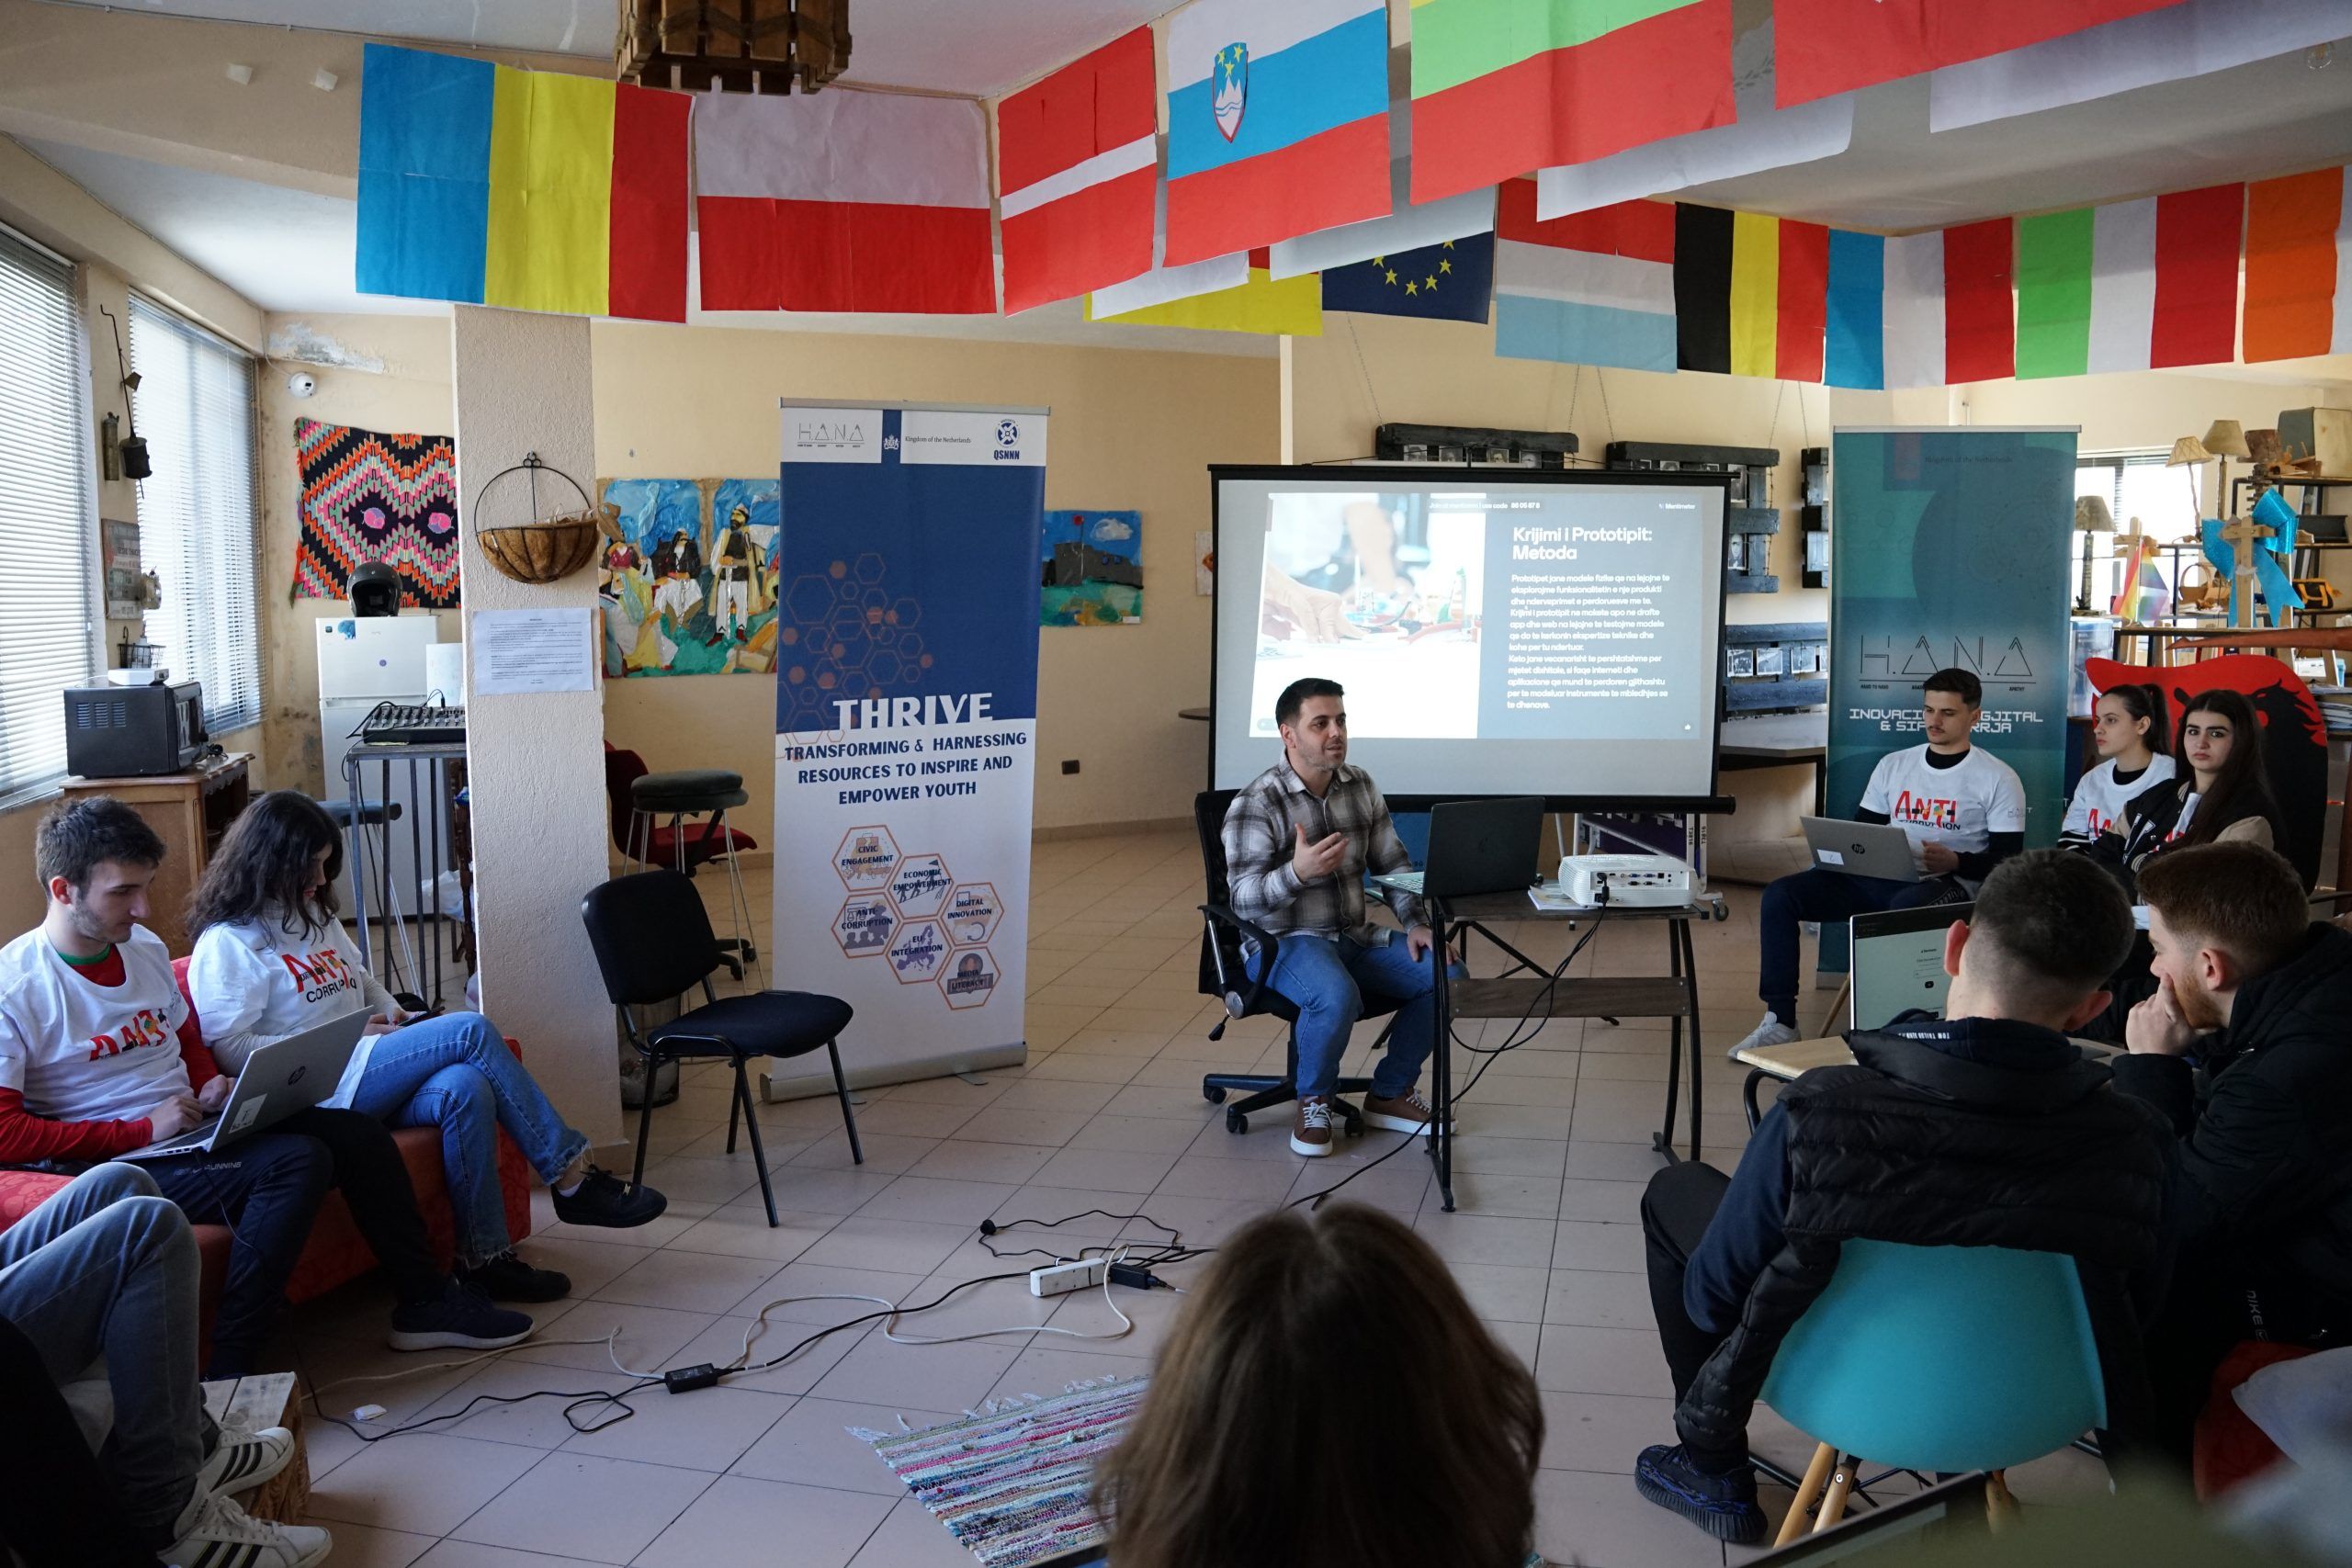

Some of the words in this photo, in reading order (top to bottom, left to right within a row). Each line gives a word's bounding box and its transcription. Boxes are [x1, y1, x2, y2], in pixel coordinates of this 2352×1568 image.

[1513, 527, 1561, 545] Krijimi
[1573, 527, 1653, 544] Prototipit:
[1513, 545, 1577, 560] Metoda
[1511, 573, 1548, 584] Prototipet
[1566, 573, 1594, 582] modele
[1595, 573, 1613, 582] fizike
[1614, 575, 1624, 584] qe
[1637, 573, 1661, 584] lejojne
[1662, 573, 1669, 582] te
[1619, 585, 1630, 596] nje
[1631, 585, 1661, 596] produkti
[1510, 596, 1525, 605] dhe
[1582, 596, 1628, 607] perdoruesve
[1510, 608, 1532, 618] Krijimi
[1536, 608, 1570, 618] prototipit
[1582, 608, 1609, 616] makete
[1611, 610, 1625, 618] apo
[1637, 608, 1660, 616] drafte
[1510, 621, 1525, 630] app
[1526, 619, 1540, 627] dhe
[1542, 619, 1556, 627] web
[1570, 619, 1593, 630] lejojne
[1594, 619, 1602, 627] te
[1603, 619, 1635, 630] testojme
[1636, 619, 1664, 627] modele
[1510, 632, 1520, 641] qe
[1521, 630, 1531, 639] do
[1532, 630, 1540, 639] te
[1541, 630, 1571, 639] kerkonin
[1611, 630, 1638, 639] teknike
[1639, 630, 1654, 639] dhe
[1510, 642, 1527, 650] kohe
[1528, 644, 1542, 652] per
[1543, 642, 1550, 650] tu
[1509, 654, 1526, 662] Keto
[1589, 654, 1596, 662] te
[1597, 654, 1647, 664] pershtatshme
[1649, 656, 1662, 664] per
[1509, 665, 1532, 675] mjetet
[1566, 665, 1572, 673] si
[1574, 665, 1590, 675] faqe
[1592, 665, 1623, 673] interneti
[1623, 665, 1638, 673] dhe
[1551, 679, 1561, 687] qe
[1562, 677, 1583, 685] mund
[1584, 677, 1592, 685] te
[1593, 677, 1628, 687] perdoren
[1629, 677, 1665, 687] gjithashtu
[1508, 690, 1521, 699] per
[1521, 688, 1529, 697] te
[1531, 688, 1566, 697] modeluar
[1566, 688, 1610, 697] instrumente
[1611, 688, 1619, 697] te
[1508, 700, 1515, 708] te
[832, 692, 993, 731] THRIVE
[1849, 708, 1926, 720] INOVACI
[1881, 720, 1891, 730] &
[785, 740, 910, 761] TRANSFORMING
[914, 741, 923, 752] &
[933, 732, 1027, 751] HARNESSING
[797, 764, 890, 784] RESOURCES
[896, 762, 916, 777] TO
[921, 758, 978, 775] INSPIRE
[982, 755, 1012, 771] AND
[839, 785, 920, 805] EMPOWER
[924, 782, 977, 797] YOUTH
[1894, 790, 1956, 826] ANTI
[858, 845, 878, 853] CIVIC
[842, 854, 894, 866] ENGAGEMENT
[903, 868, 942, 879] ECONOMIC
[893, 878, 951, 891] EMPOWERMENT
[956, 897, 984, 908] DIGITAL
[947, 908, 992, 919] INNOVATION
[842, 918, 893, 931] CORRUPTION
[912, 935, 923, 943] EU
[891, 944, 943, 956] INTEGRATION
[281, 949, 351, 994] ANT
[2246, 1289, 2263, 1325] NIKE
